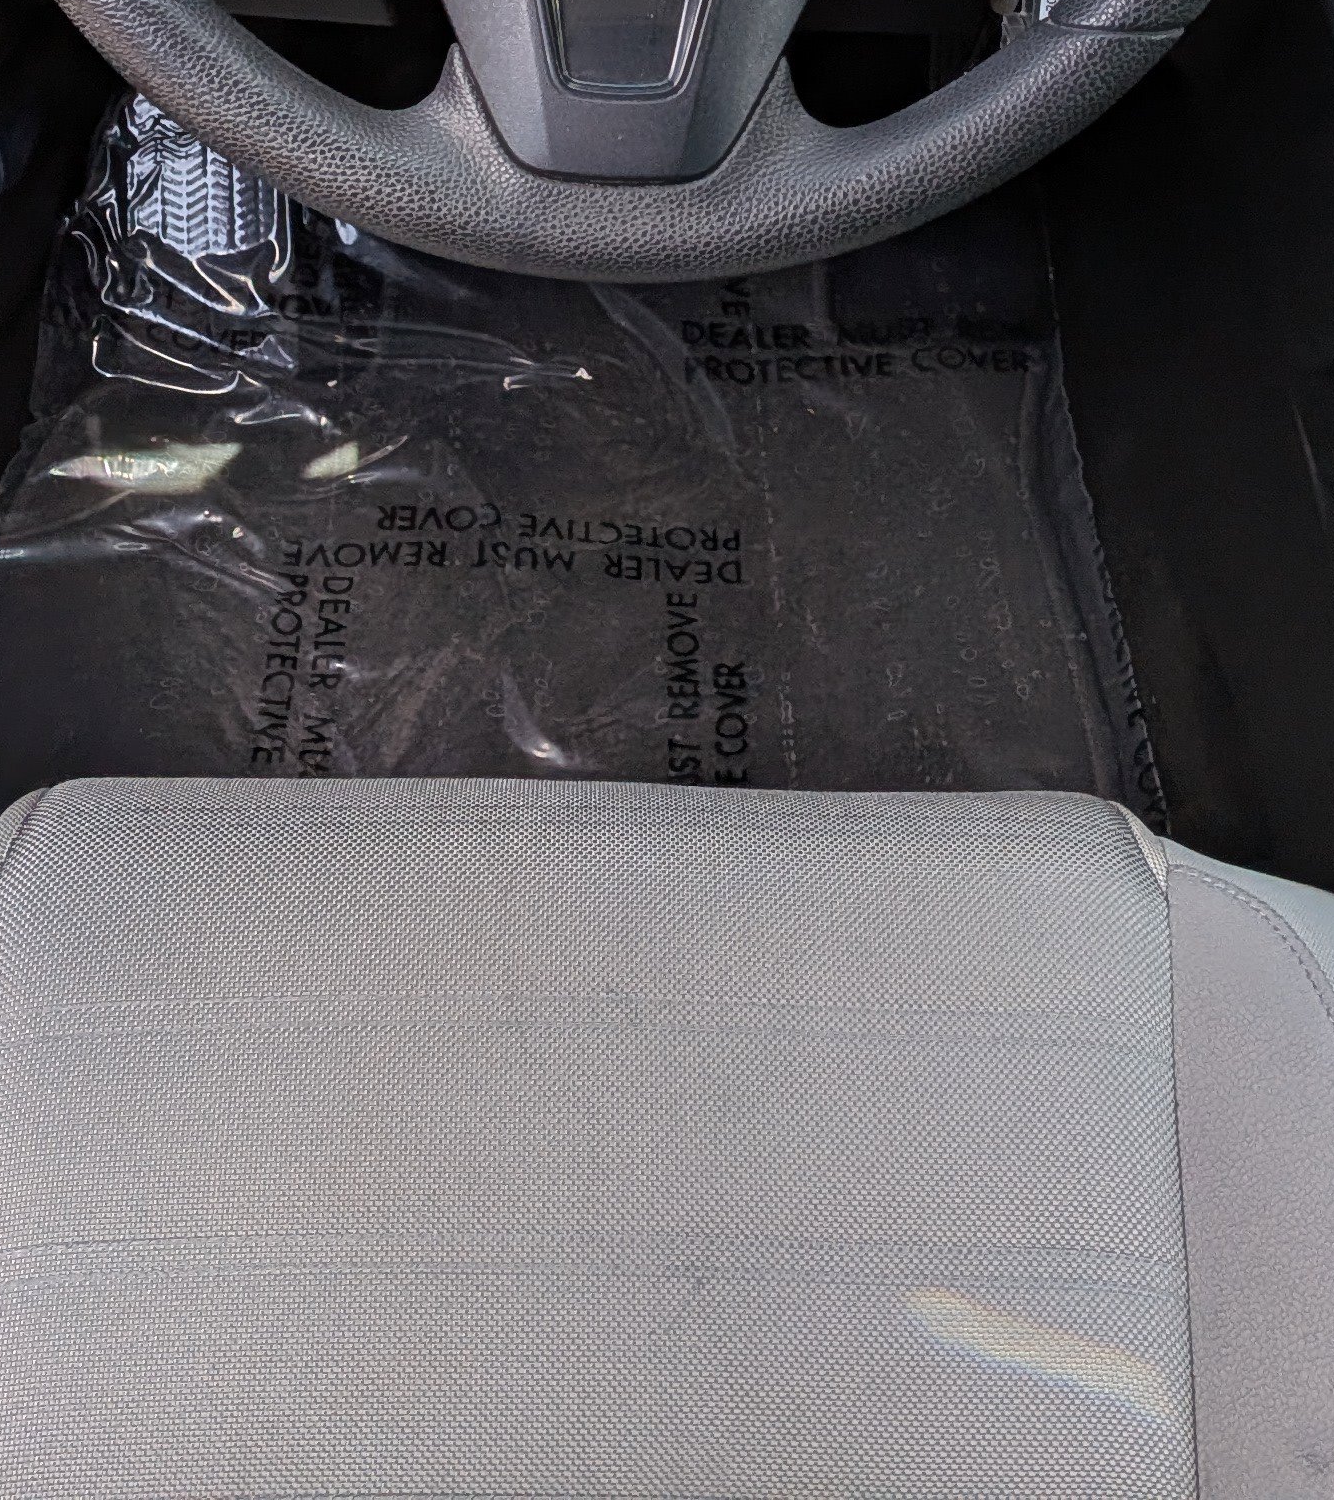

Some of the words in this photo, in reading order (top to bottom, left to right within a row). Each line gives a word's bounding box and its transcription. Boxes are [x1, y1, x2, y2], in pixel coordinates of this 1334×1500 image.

[681, 320, 810, 349] DEALER
[684, 353, 898, 386] PROTECTIVE
[911, 346, 1031, 374] COVER
[377, 502, 502, 534] COVER
[518, 513, 741, 553] PROTECTIVE
[281, 538, 448, 569] REMOVE
[471, 540, 576, 574] MUST
[605, 553, 743, 585] DEALER
[309, 575, 354, 691] DEALER
[250, 574, 310, 765] PROTECTIVE
[665, 592, 702, 720] REMOVE
[712, 661, 748, 756] COVER
